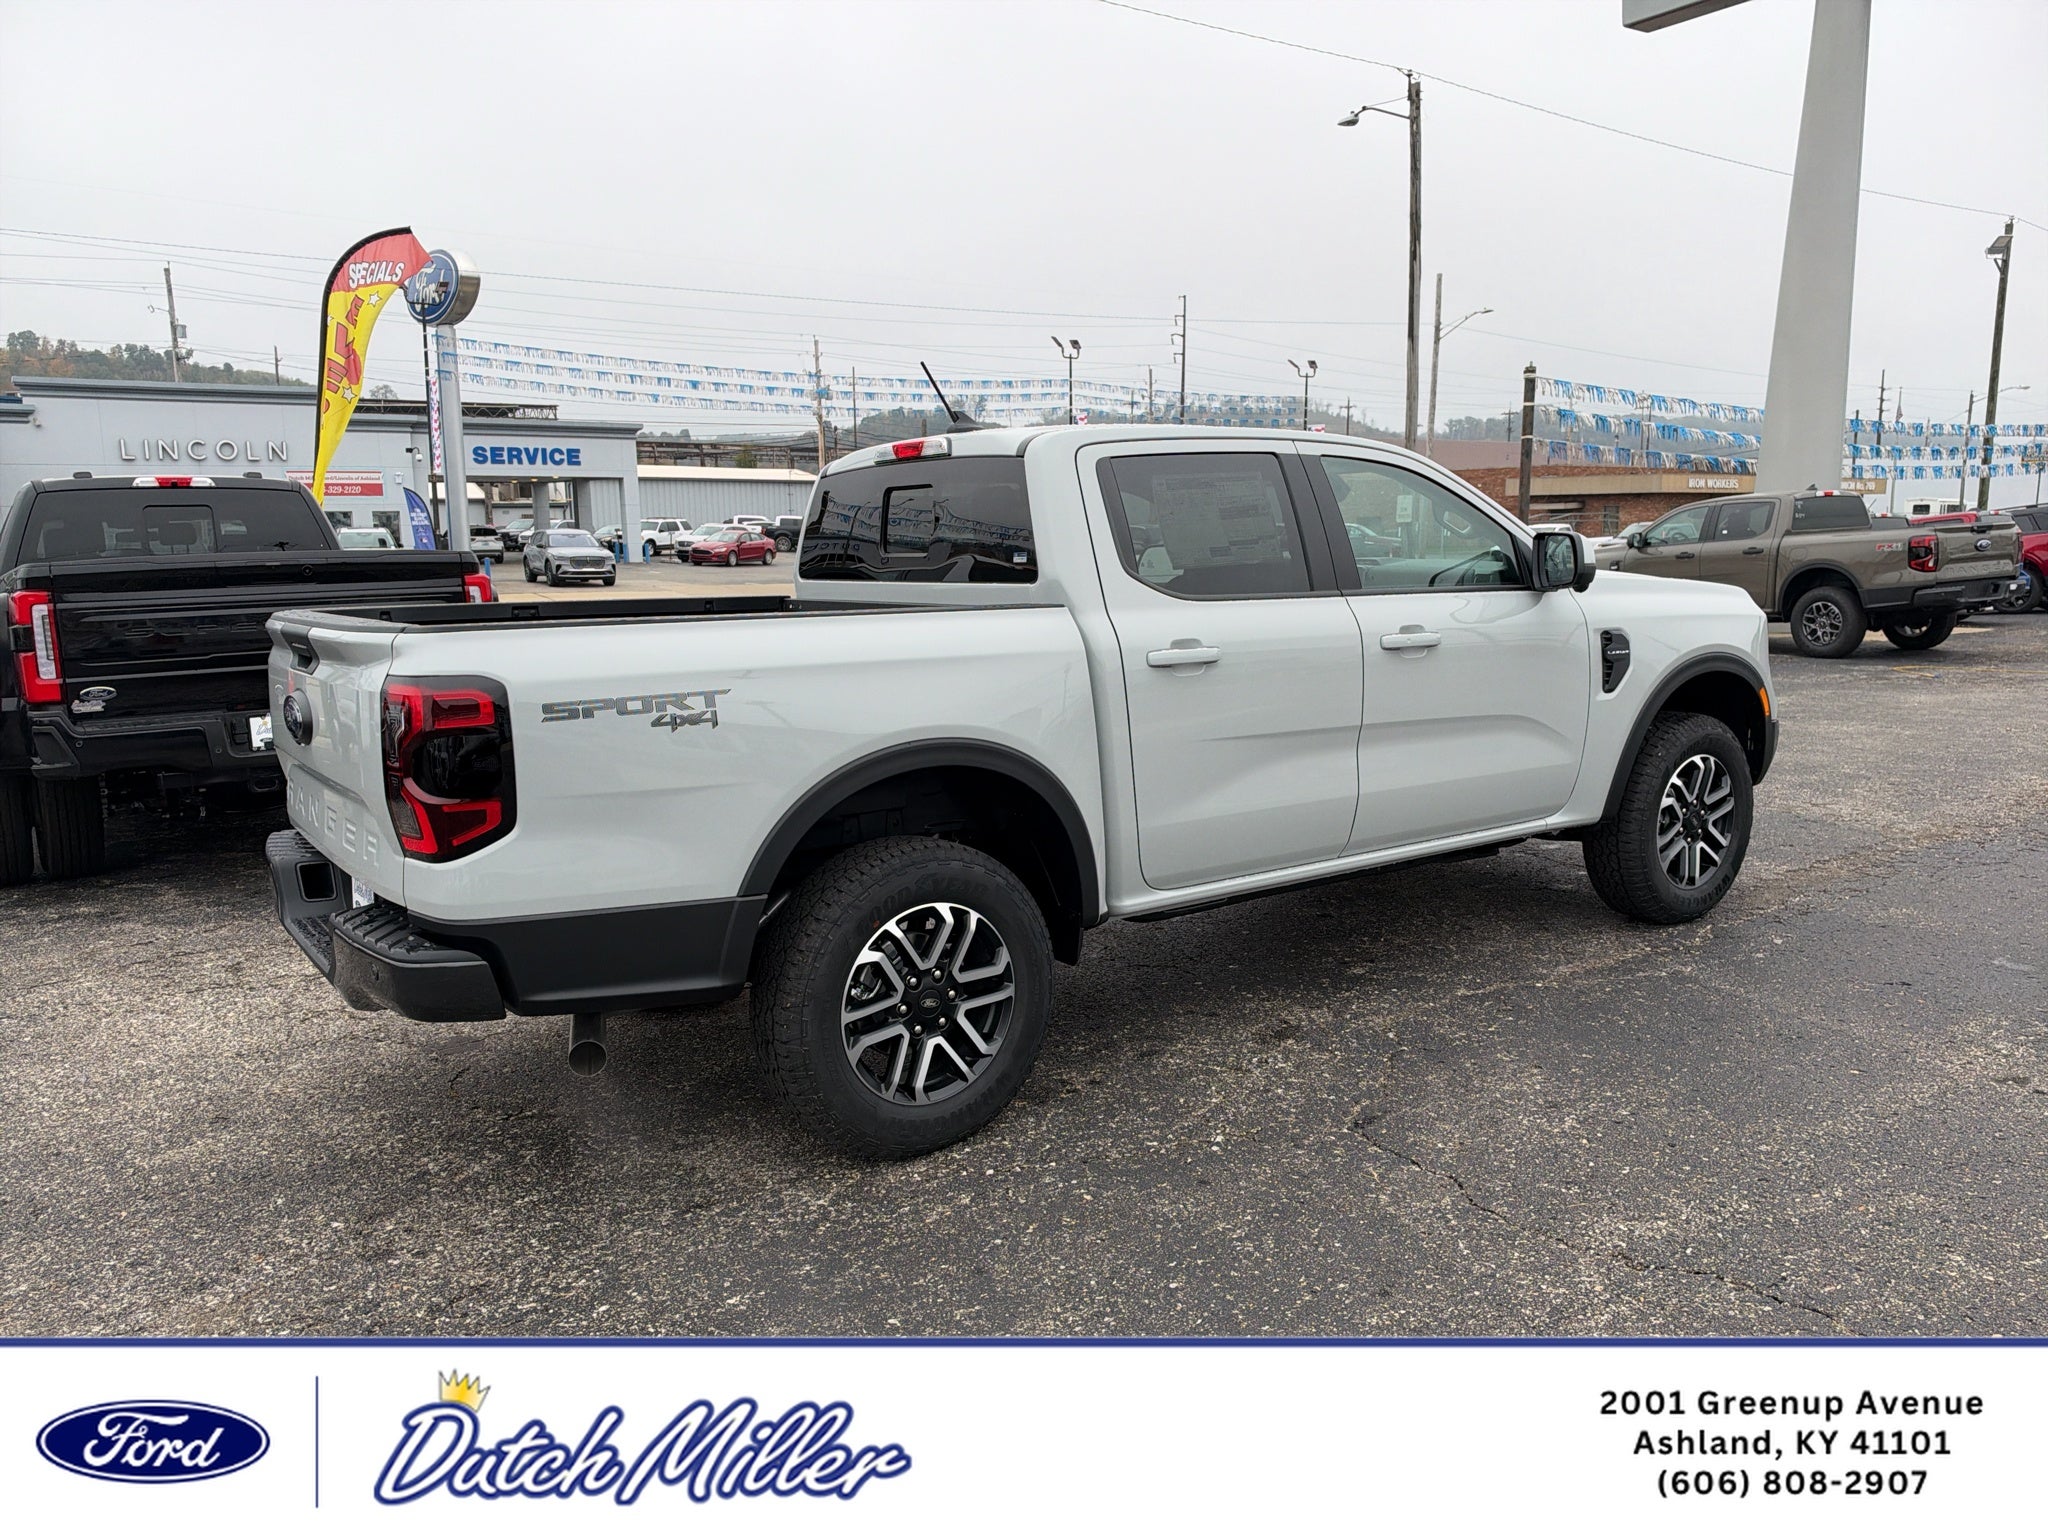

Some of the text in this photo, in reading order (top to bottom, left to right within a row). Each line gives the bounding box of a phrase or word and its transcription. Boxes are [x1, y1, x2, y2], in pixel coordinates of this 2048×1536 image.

[348, 260, 405, 289] SPECIALS
[119, 438, 288, 461] LINCOLN
[472, 446, 582, 466] SERVICE
[1688, 477, 1705, 489] IRON
[1706, 477, 1739, 489] WORKERS
[1875, 543, 1903, 551] FX4
[88, 689, 109, 698] Ford
[541, 688, 732, 723] SPORT
[650, 710, 719, 733] 4x4
[286, 776, 379, 869] RANGER
